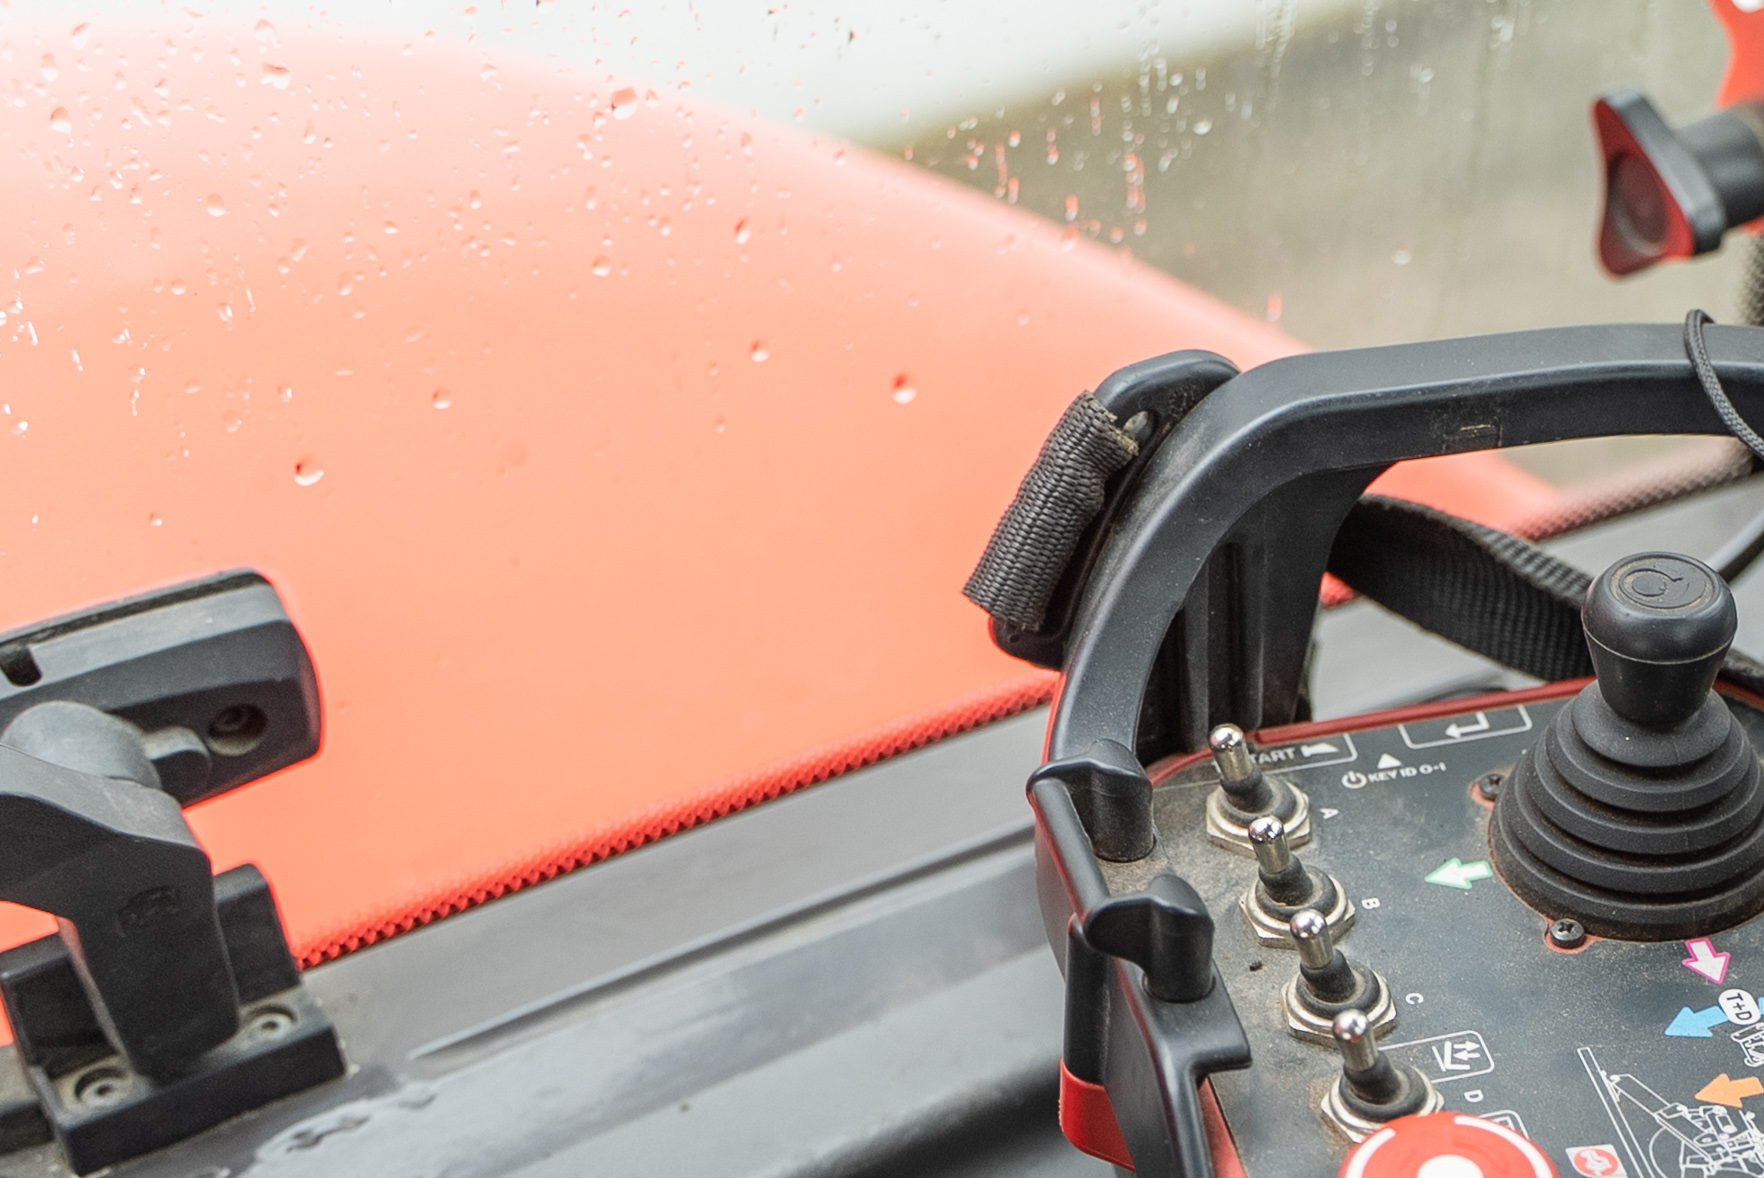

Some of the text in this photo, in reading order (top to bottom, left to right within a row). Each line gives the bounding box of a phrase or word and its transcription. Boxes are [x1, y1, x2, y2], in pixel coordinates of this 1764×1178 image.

[1248, 747, 1296, 765] TART
[1367, 768, 1398, 783] KEY
[1400, 766, 1418, 778] ID
[1319, 808, 1339, 820] A
[1361, 897, 1381, 910] B
[1405, 992, 1424, 1005] C
[1726, 992, 1753, 1021] T+D
[1463, 1089, 1484, 1103] D
